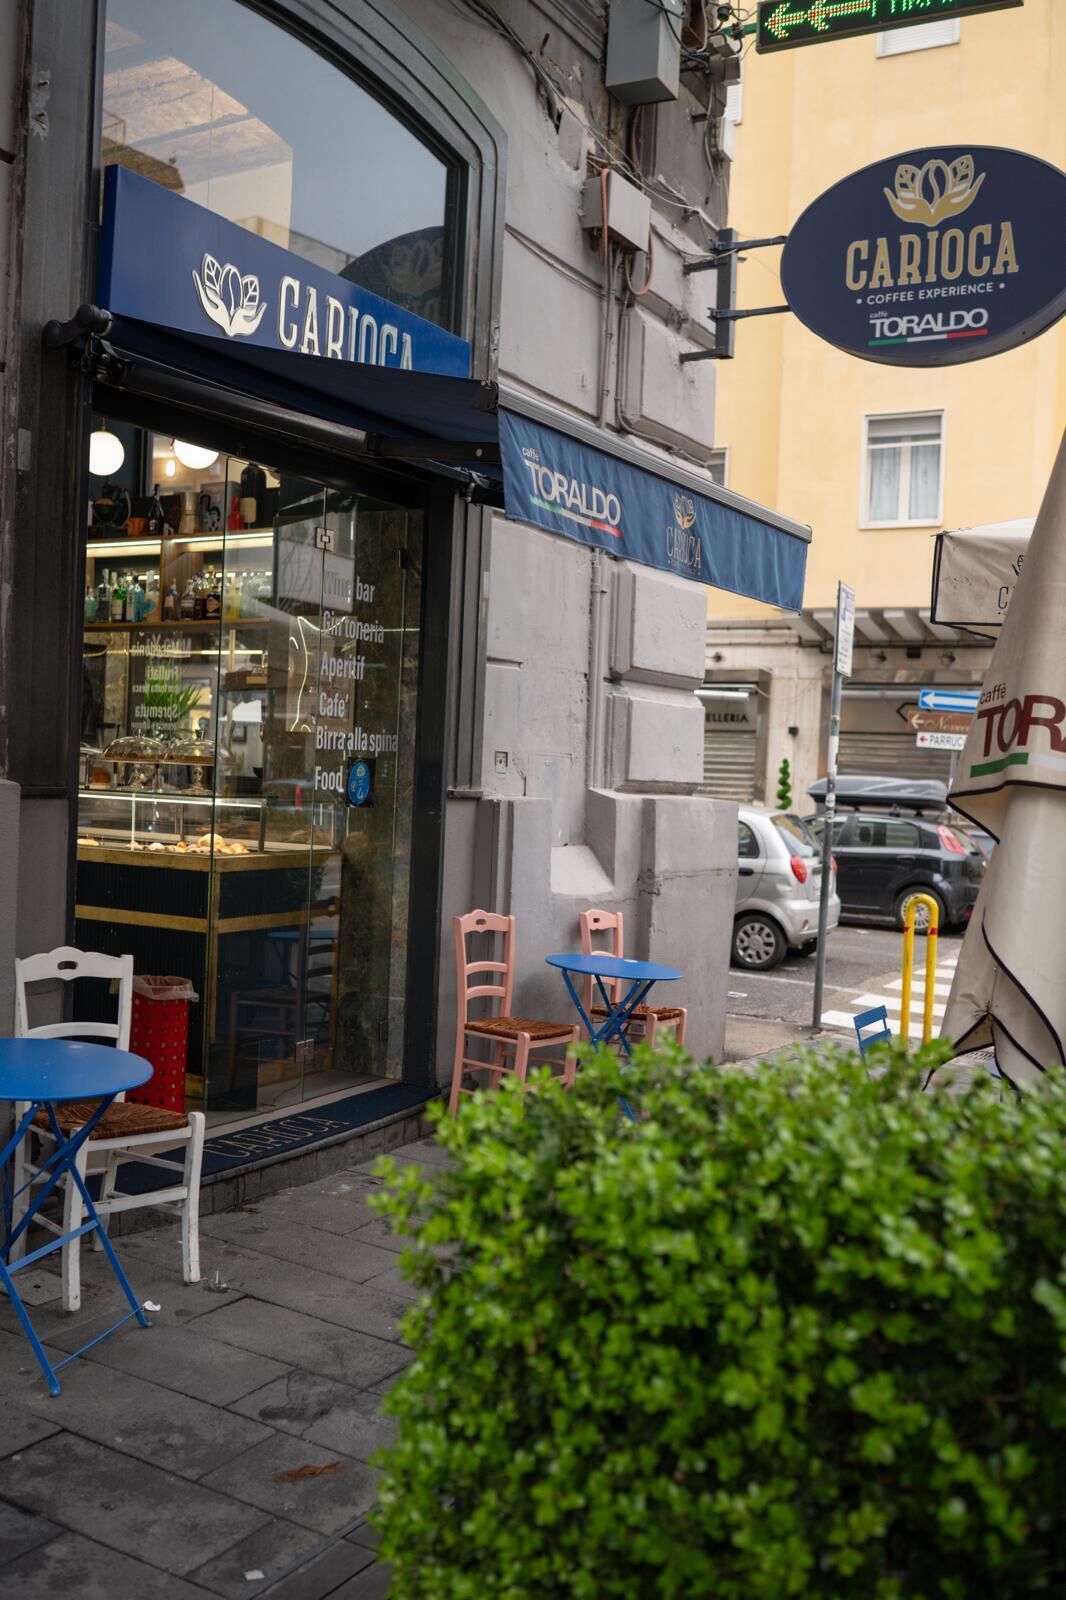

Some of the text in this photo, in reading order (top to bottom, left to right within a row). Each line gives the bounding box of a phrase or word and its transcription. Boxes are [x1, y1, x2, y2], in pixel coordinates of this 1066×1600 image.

[845, 221, 1019, 291] CARIOCA
[866, 282, 994, 305] COFFEE EXPERIENCE
[278, 275, 414, 370] CARIOCA
[869, 308, 989, 338] TORALDO
[524, 459, 621, 526] TORALDO
[356, 576, 376, 603] bar
[322, 610, 342, 636] Gin
[320, 651, 365, 682] Aperitif
[980, 682, 1007, 704] caffè
[316, 725, 398, 758] Birra alla spina
[977, 694, 1066, 758] TOR
[314, 765, 344, 791] Food
[203, 1116, 350, 1158] CARIOCA
